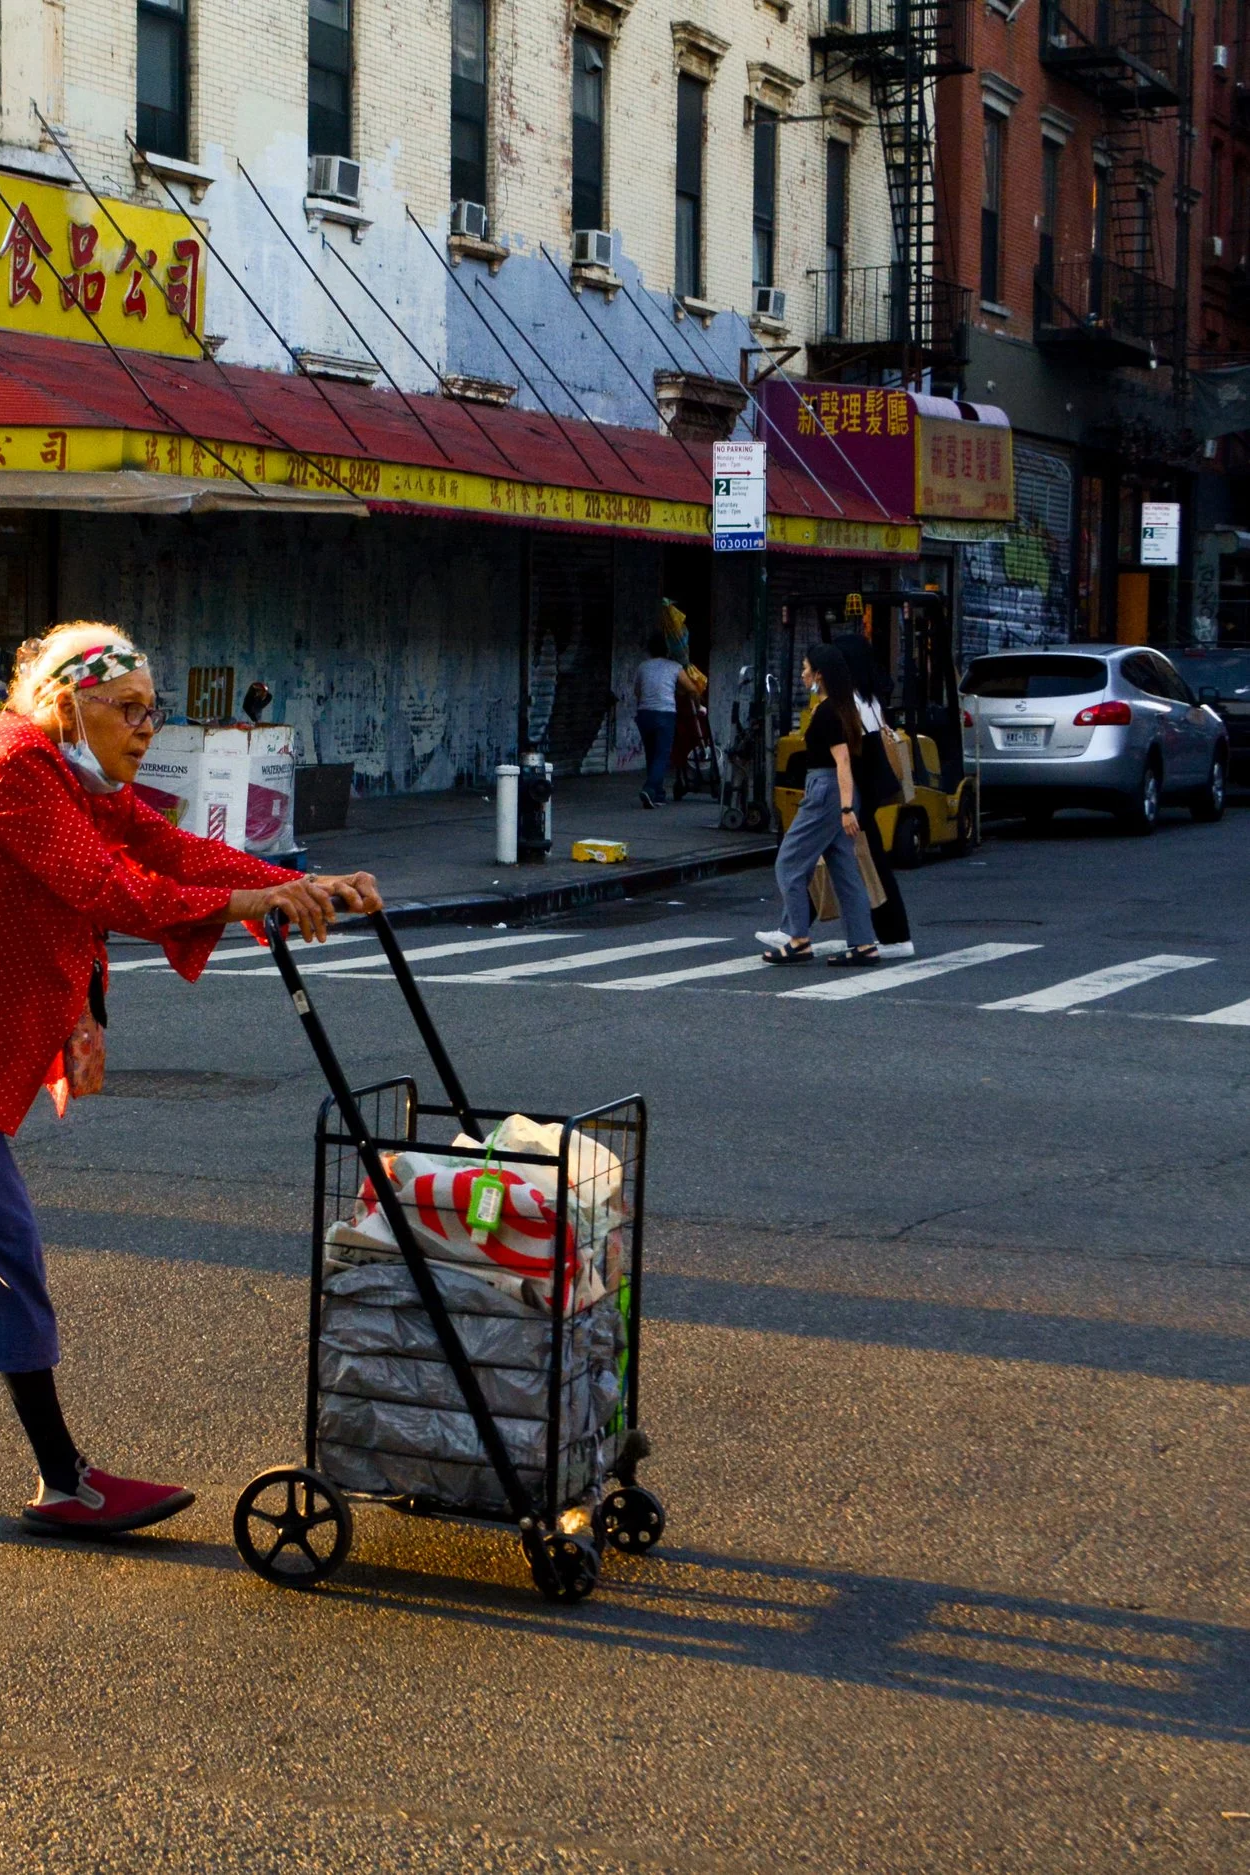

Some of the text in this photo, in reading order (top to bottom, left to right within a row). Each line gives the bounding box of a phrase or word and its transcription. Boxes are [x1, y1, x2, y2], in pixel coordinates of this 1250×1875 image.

[716, 445, 754, 453] NO PARKING
[145, 435, 266, 482] 瑞利食品公司
[286, 456, 381, 493] 212-334-8429
[718, 480, 727, 495] 2
[584, 492, 651, 525] 212-334-8429
[716, 539, 753, 549] 103001
[139, 763, 189, 775] ATERMELONS
